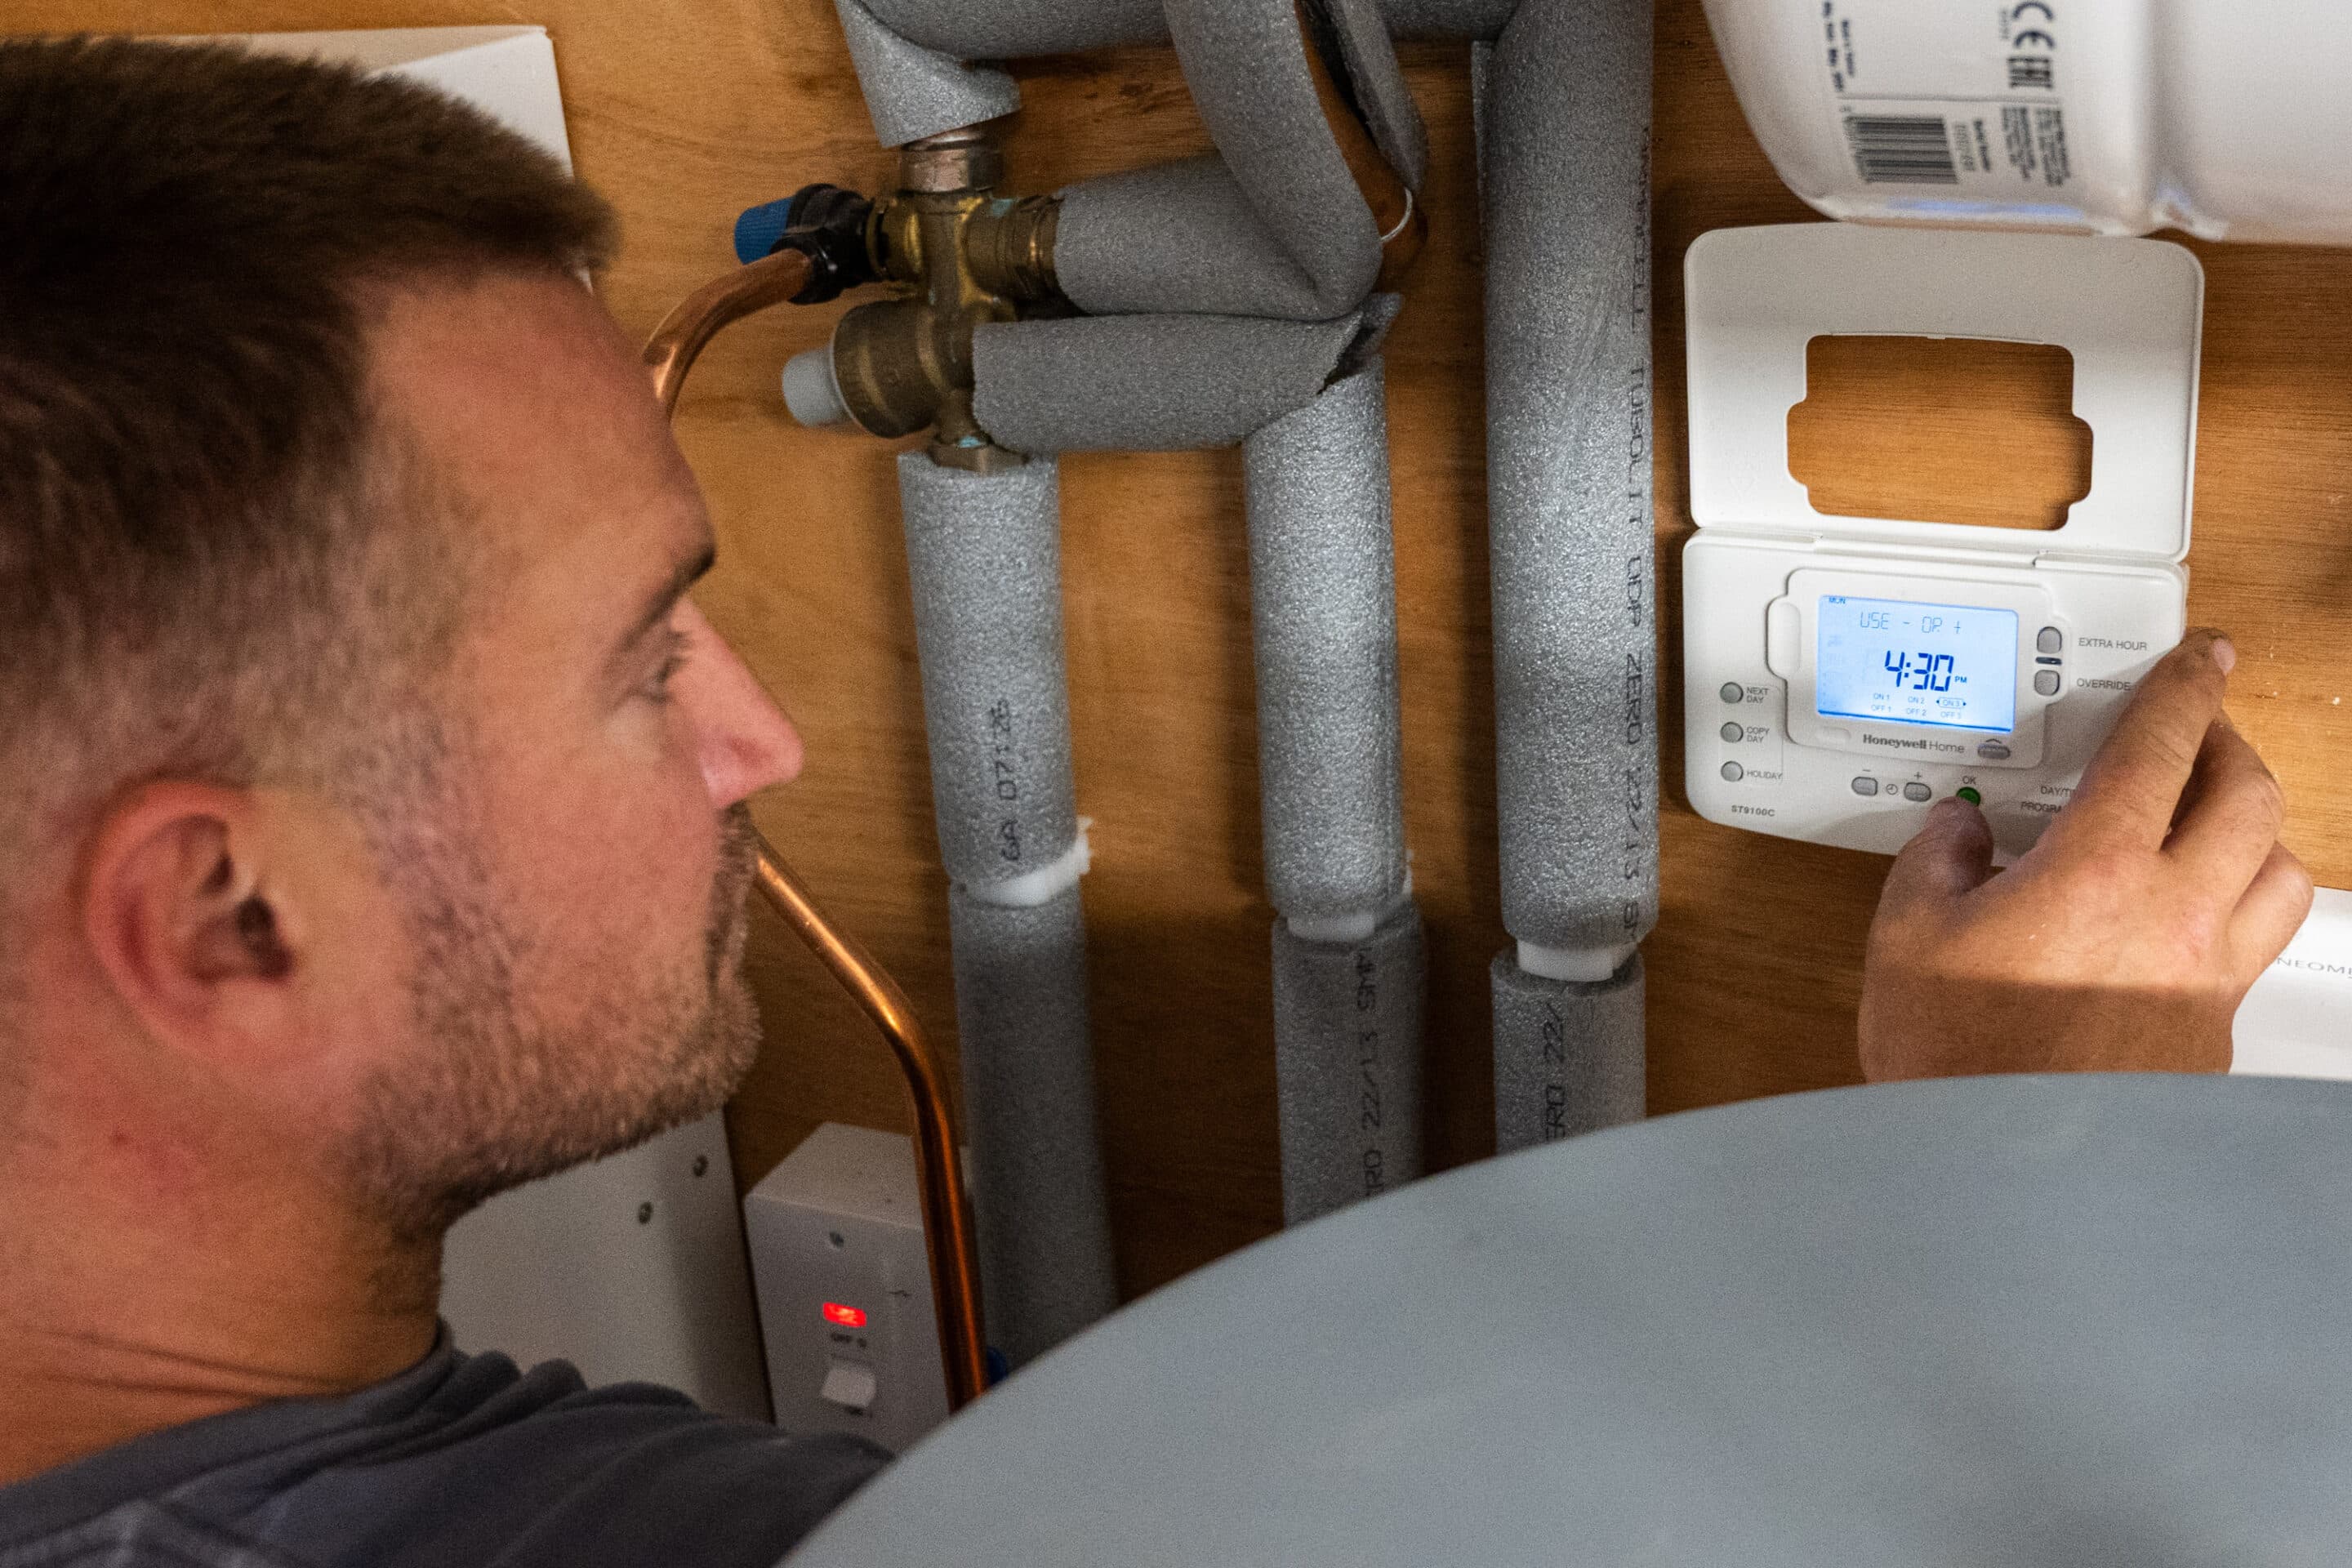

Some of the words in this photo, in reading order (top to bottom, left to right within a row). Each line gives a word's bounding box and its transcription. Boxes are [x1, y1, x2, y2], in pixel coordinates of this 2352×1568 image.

[1628, 362, 1645, 530] TUBOLIT
[1860, 611, 1890, 630] USE
[2078, 637, 2114, 649] EXTRA
[2115, 640, 2148, 651] HOUR
[1884, 650, 1954, 692] 4:30
[1954, 675, 1967, 684] PM
[2076, 678, 2132, 692] OVERRIDE
[1746, 687, 1770, 696] NEXT
[1624, 653, 1643, 745] ZERO
[1746, 695, 1765, 704] DAY
[1873, 693, 1884, 701] ON
[1908, 696, 1918, 704] ON
[1870, 704, 1886, 712] OFF
[1942, 699, 1954, 707] ON
[1905, 707, 1920, 715] OFF
[1940, 710, 1955, 719] OFF
[1746, 726, 1771, 736] COPY
[1746, 735, 1765, 744] DAY
[1862, 733, 1927, 750] Honeywell
[1928, 739, 1966, 754] Home
[1746, 769, 1784, 780] HOLIDAY
[1962, 776, 1976, 786] OK
[1731, 804, 1775, 817] ST9100C
[1360, 1031, 1380, 1130] 22/13
